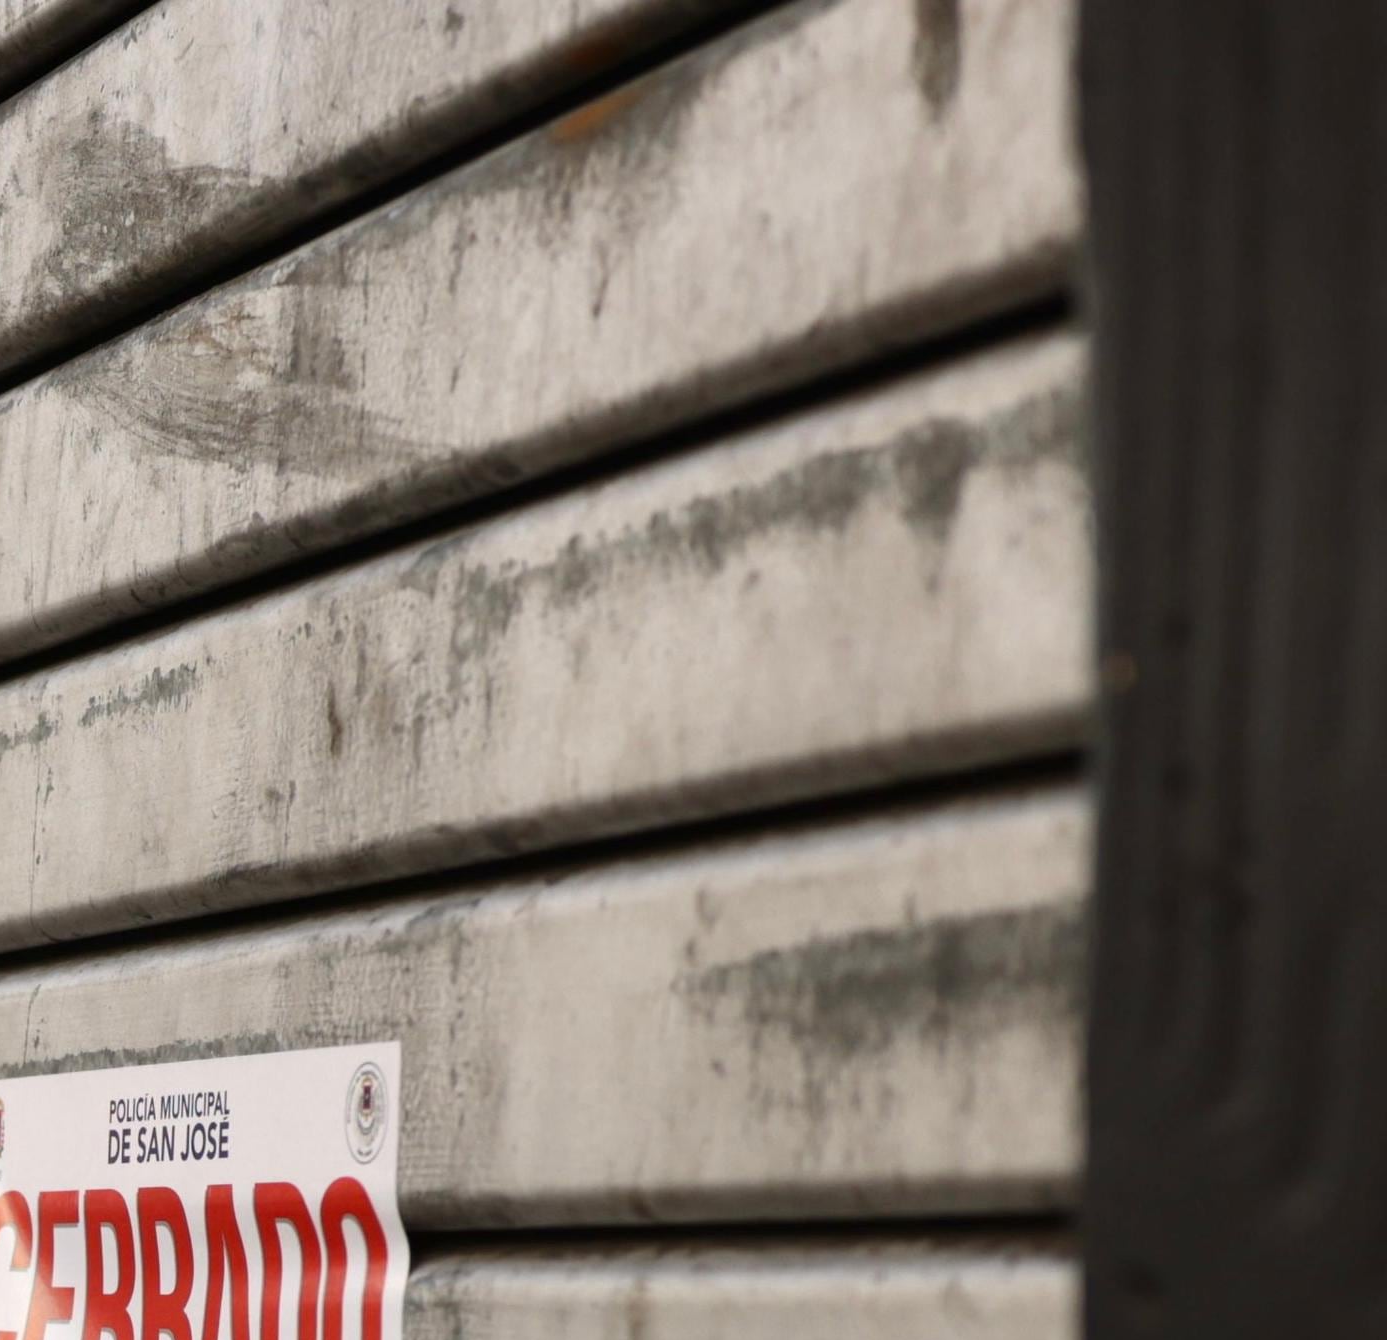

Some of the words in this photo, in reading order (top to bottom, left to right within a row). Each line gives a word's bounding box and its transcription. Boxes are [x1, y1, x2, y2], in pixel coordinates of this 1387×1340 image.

[109, 1093, 156, 1123] POLICÍA
[160, 1090, 230, 1119] MUNICIPAL
[108, 1128, 131, 1164] DE
[136, 1125, 175, 1163] SAN
[180, 1117, 229, 1161] JOSÉ
